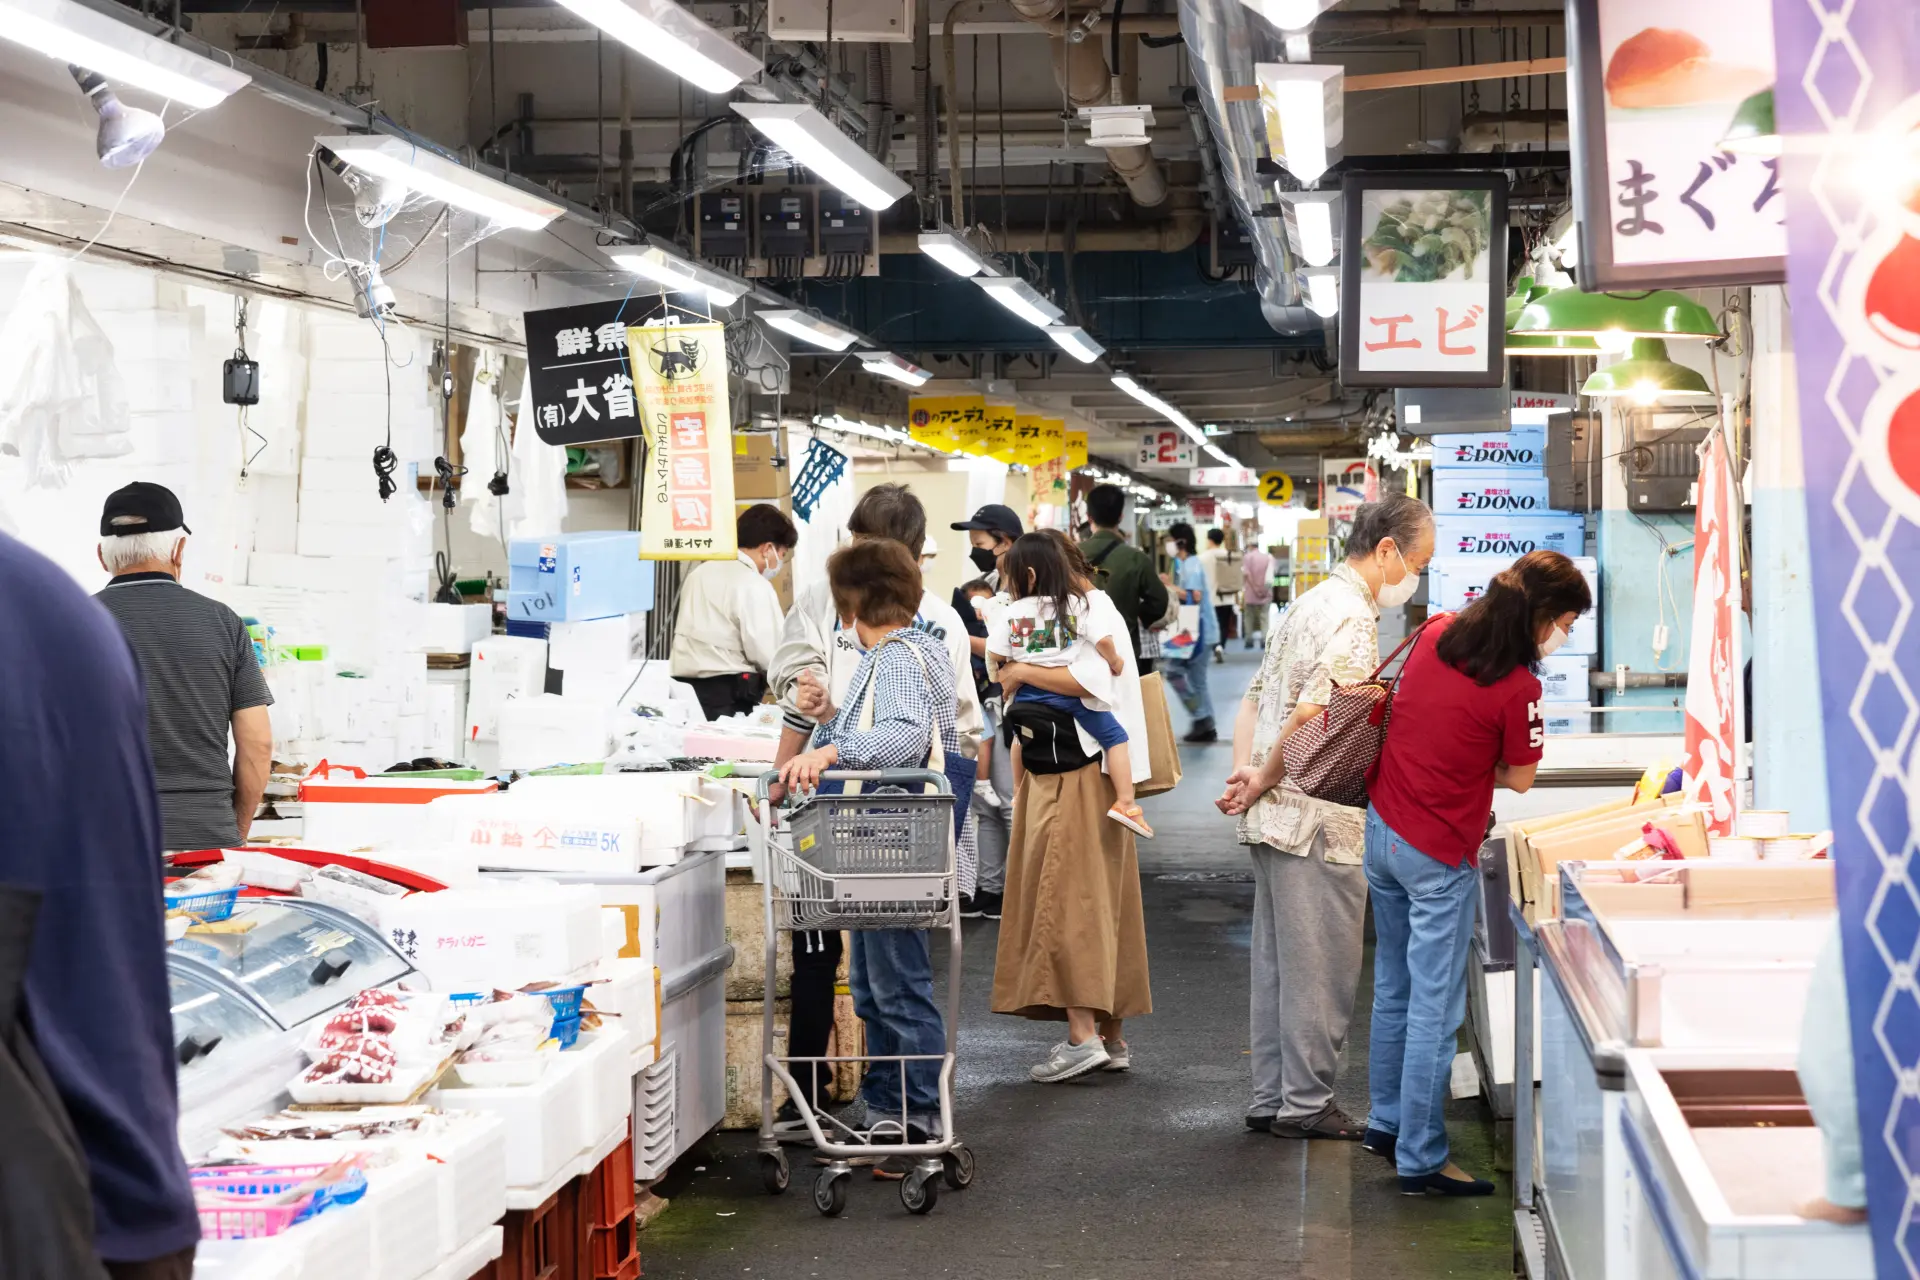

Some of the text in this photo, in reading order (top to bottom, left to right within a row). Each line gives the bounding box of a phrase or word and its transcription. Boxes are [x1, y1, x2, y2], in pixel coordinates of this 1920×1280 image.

[1364, 304, 1485, 357] エビ
[1158, 431, 1177, 463] 2
[1455, 445, 1533, 463] EDONO
[1140, 450, 1148, 463] 3
[1266, 476, 1285, 501] 2
[1457, 492, 1535, 510] EDONO
[1458, 536, 1536, 554] EDONO
